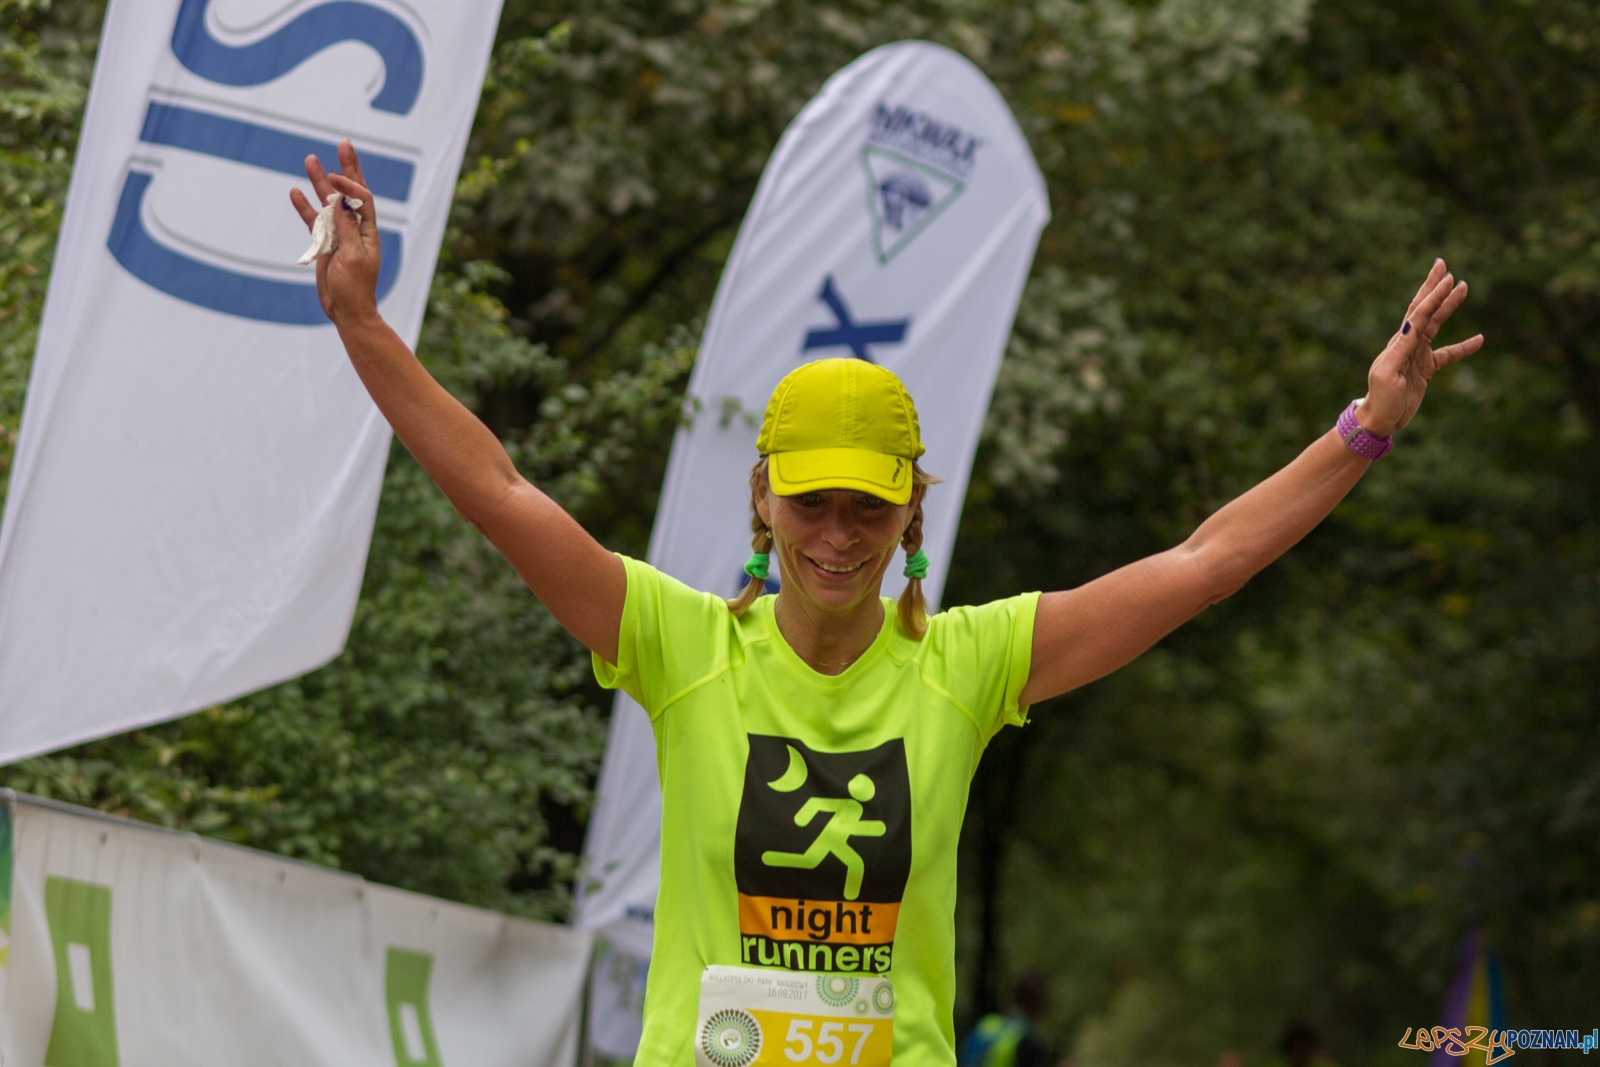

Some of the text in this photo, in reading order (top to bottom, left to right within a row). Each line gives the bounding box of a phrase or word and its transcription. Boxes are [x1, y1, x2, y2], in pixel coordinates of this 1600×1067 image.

[771, 901, 872, 940] night
[743, 937, 891, 973] runners
[757, 977, 773, 987] PARK
[776, 979, 808, 990] NARODOWY
[784, 1018, 874, 1065] 557
